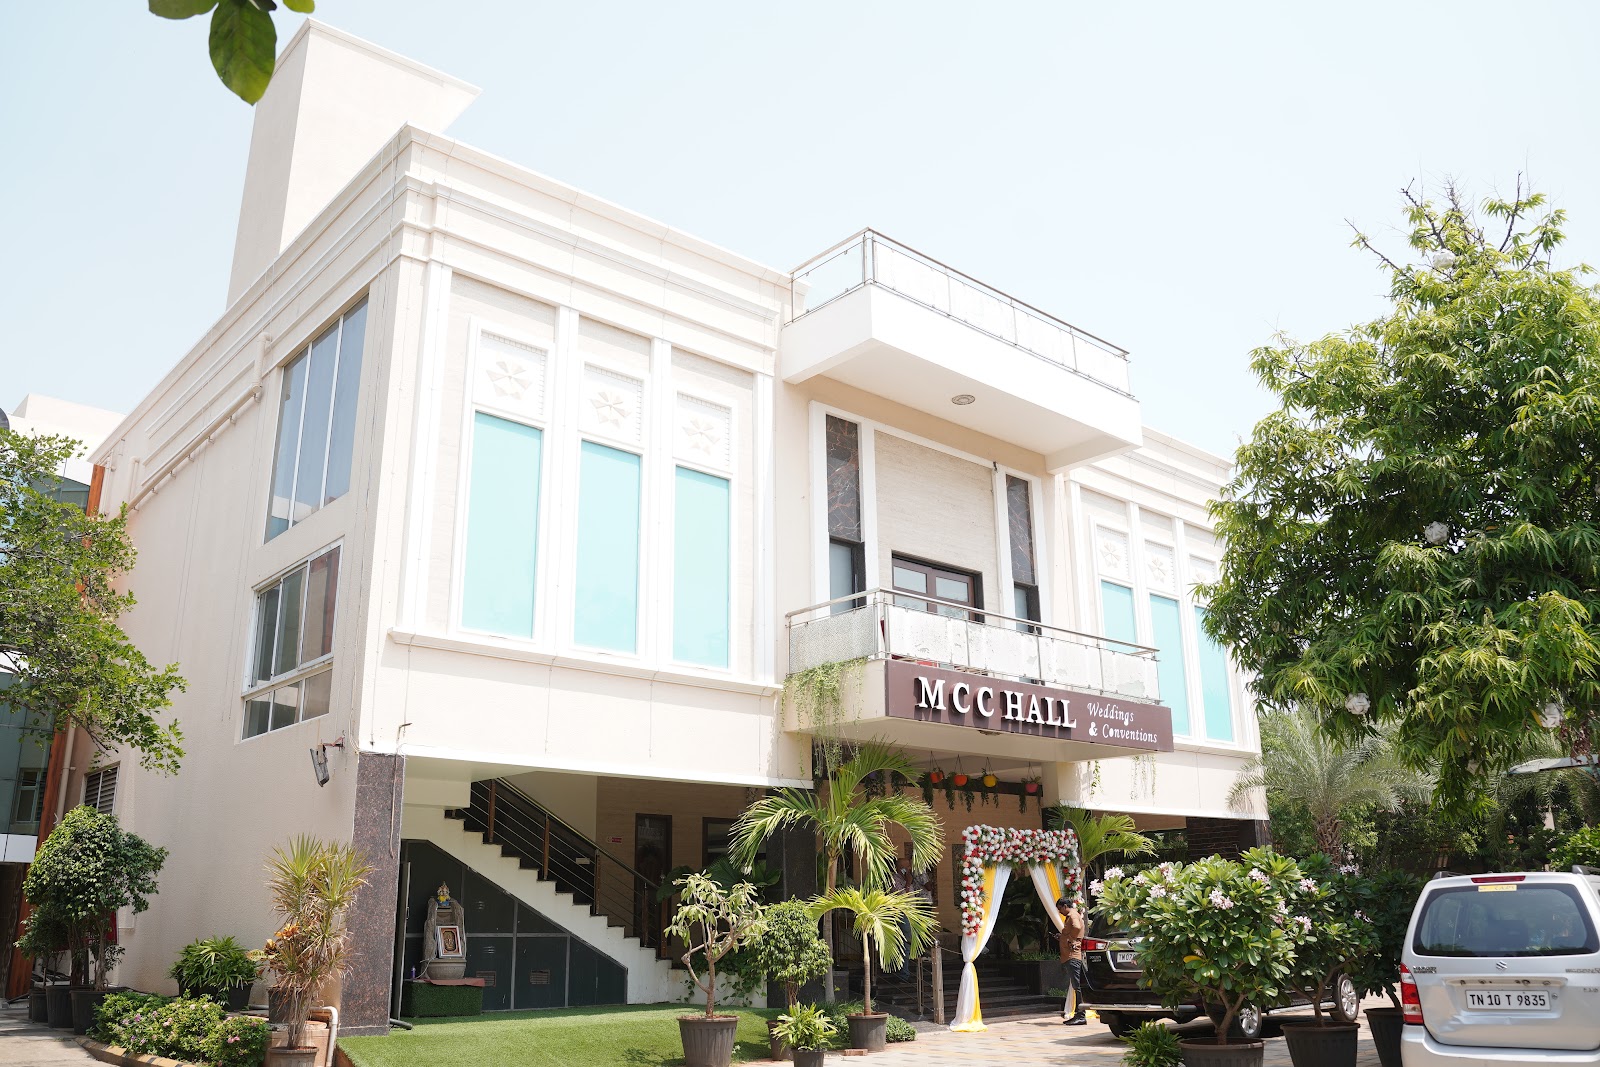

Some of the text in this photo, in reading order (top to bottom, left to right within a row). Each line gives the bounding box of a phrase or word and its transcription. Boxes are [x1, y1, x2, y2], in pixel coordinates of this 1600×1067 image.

[917, 676, 1077, 729] MCC HALL
[1087, 702, 1135, 726] Weddings
[1088, 721, 1158, 744] & Conventions
[1469, 994, 1546, 1007] TN 10 T 9835
